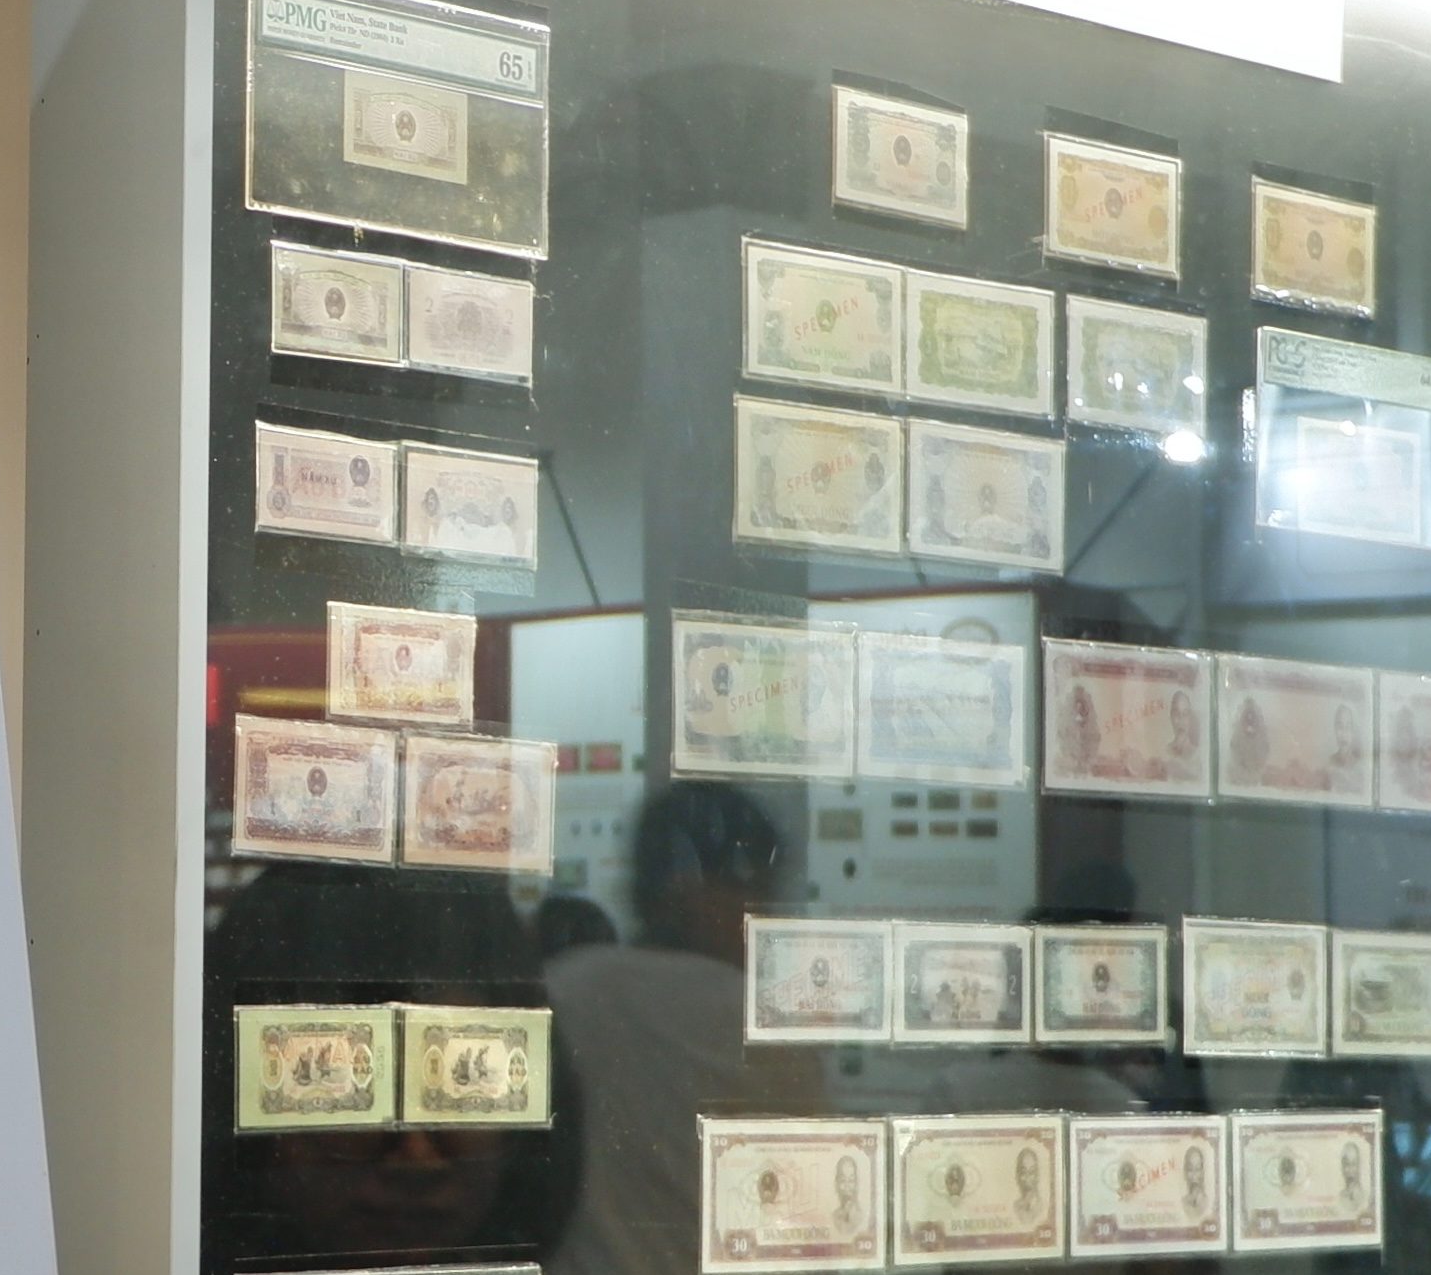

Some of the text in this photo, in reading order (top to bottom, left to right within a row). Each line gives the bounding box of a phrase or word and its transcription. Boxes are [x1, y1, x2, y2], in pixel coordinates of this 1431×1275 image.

[284, 1, 327, 33] PMG
[499, 51, 524, 81] 65
[921, 1229, 937, 1243] 30
[1096, 1223, 1111, 1236] 30
[731, 1237, 748, 1252] 30
